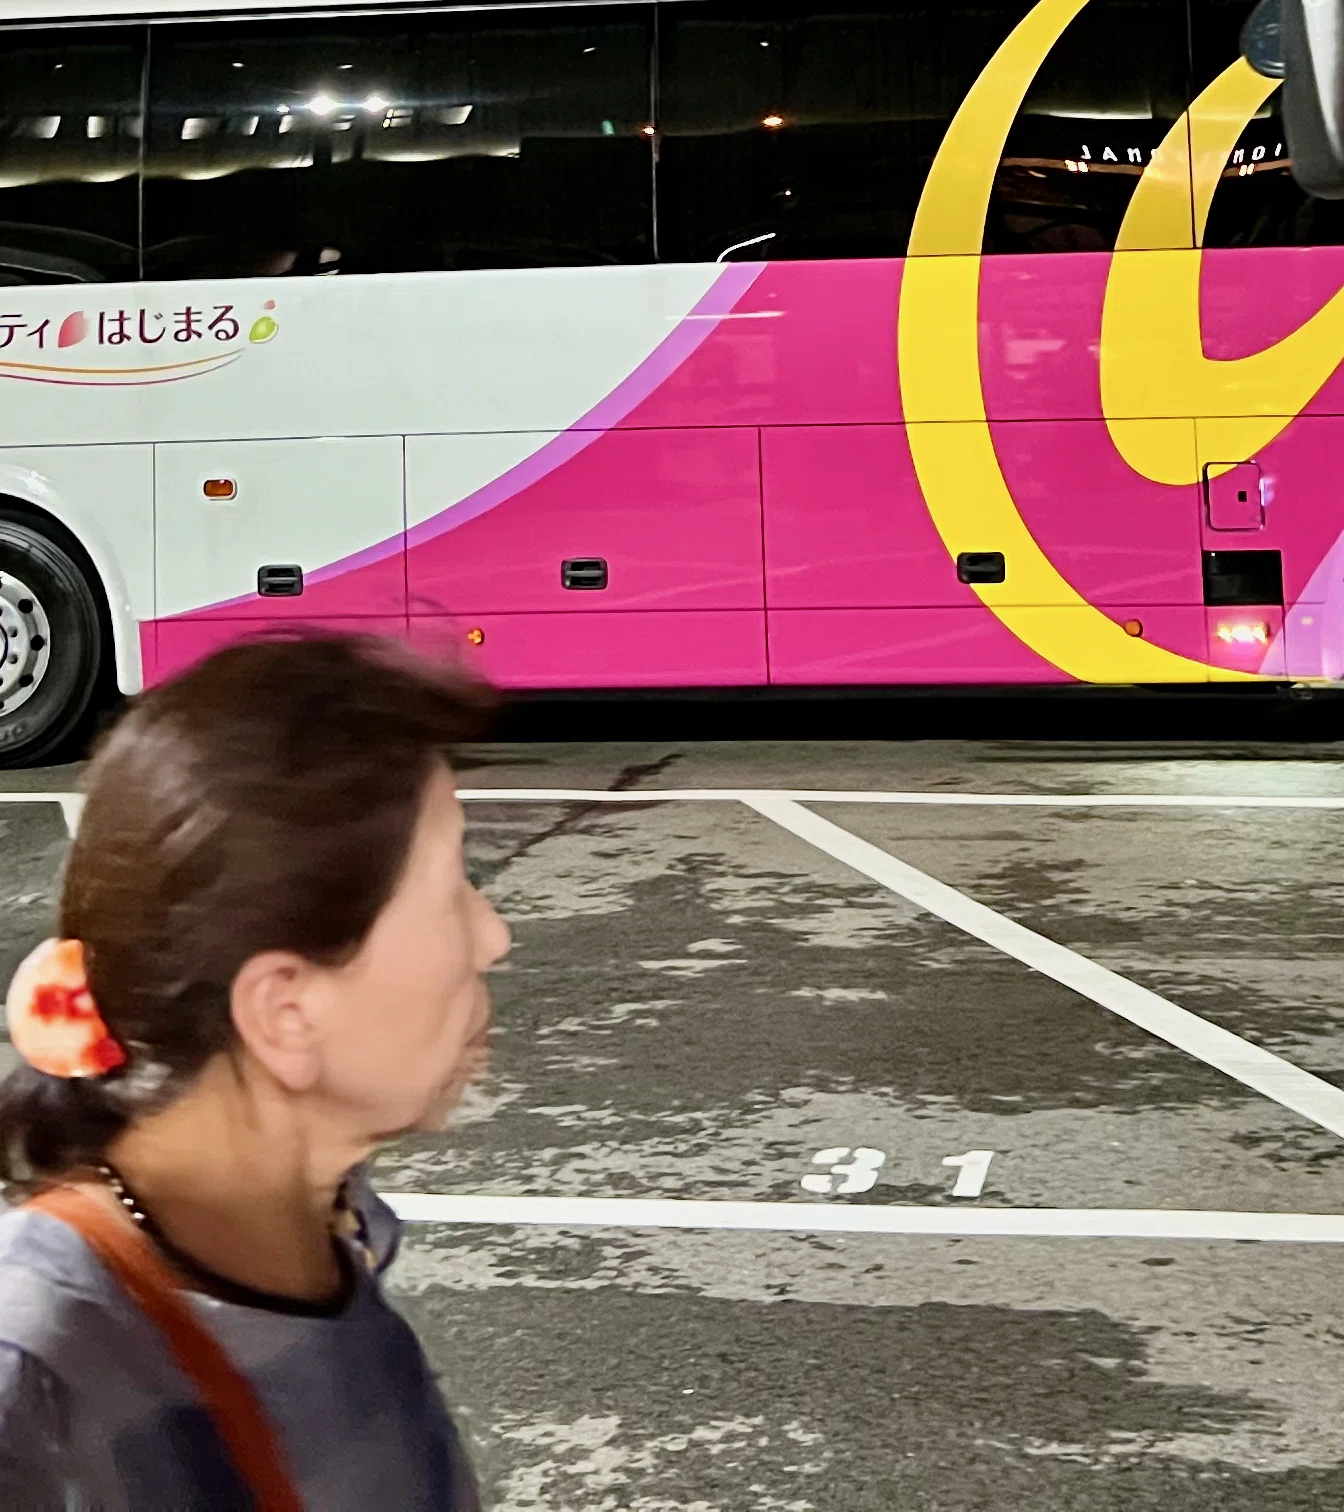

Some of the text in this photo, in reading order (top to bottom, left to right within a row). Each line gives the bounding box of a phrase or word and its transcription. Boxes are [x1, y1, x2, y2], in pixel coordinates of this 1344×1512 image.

[97, 304, 240, 346] はじまる
[799, 1145, 995, 1198] 31
